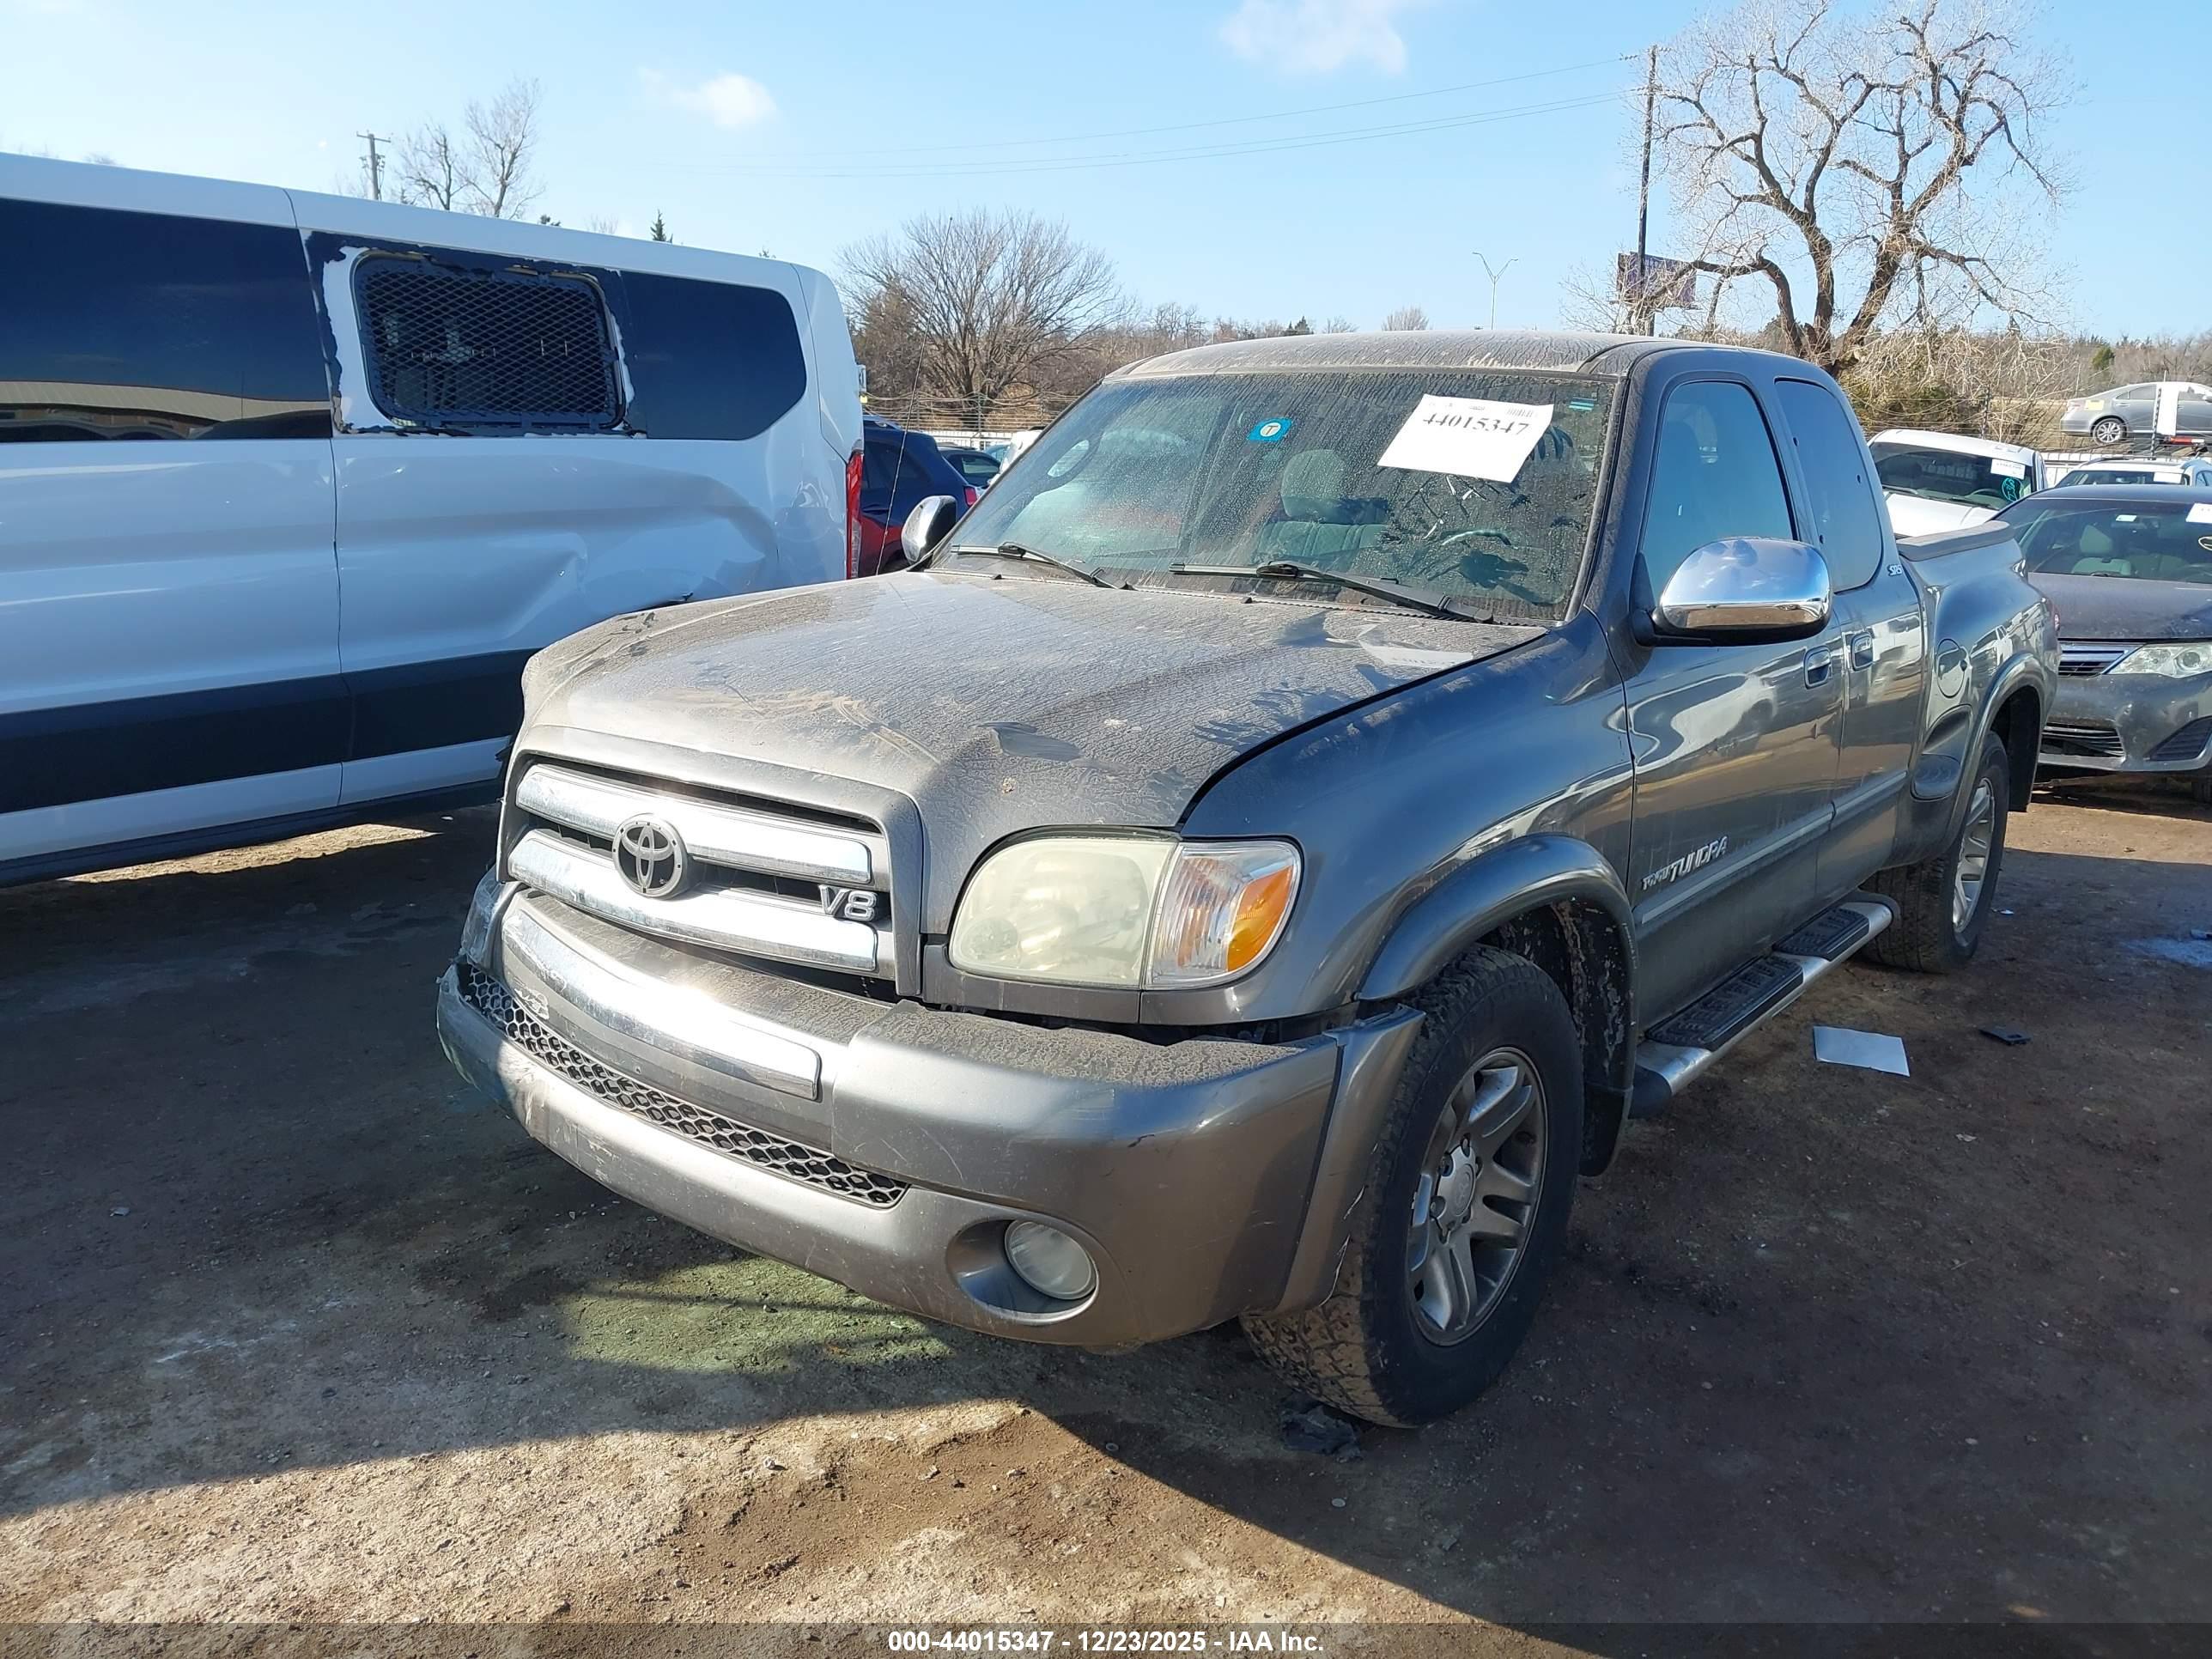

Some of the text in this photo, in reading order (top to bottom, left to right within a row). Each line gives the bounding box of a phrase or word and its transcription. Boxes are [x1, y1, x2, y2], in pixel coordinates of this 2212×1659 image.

[1422, 412, 1531, 435] 44015347
[1669, 836, 1729, 883] TUNDRA
[817, 884, 878, 922] V8
